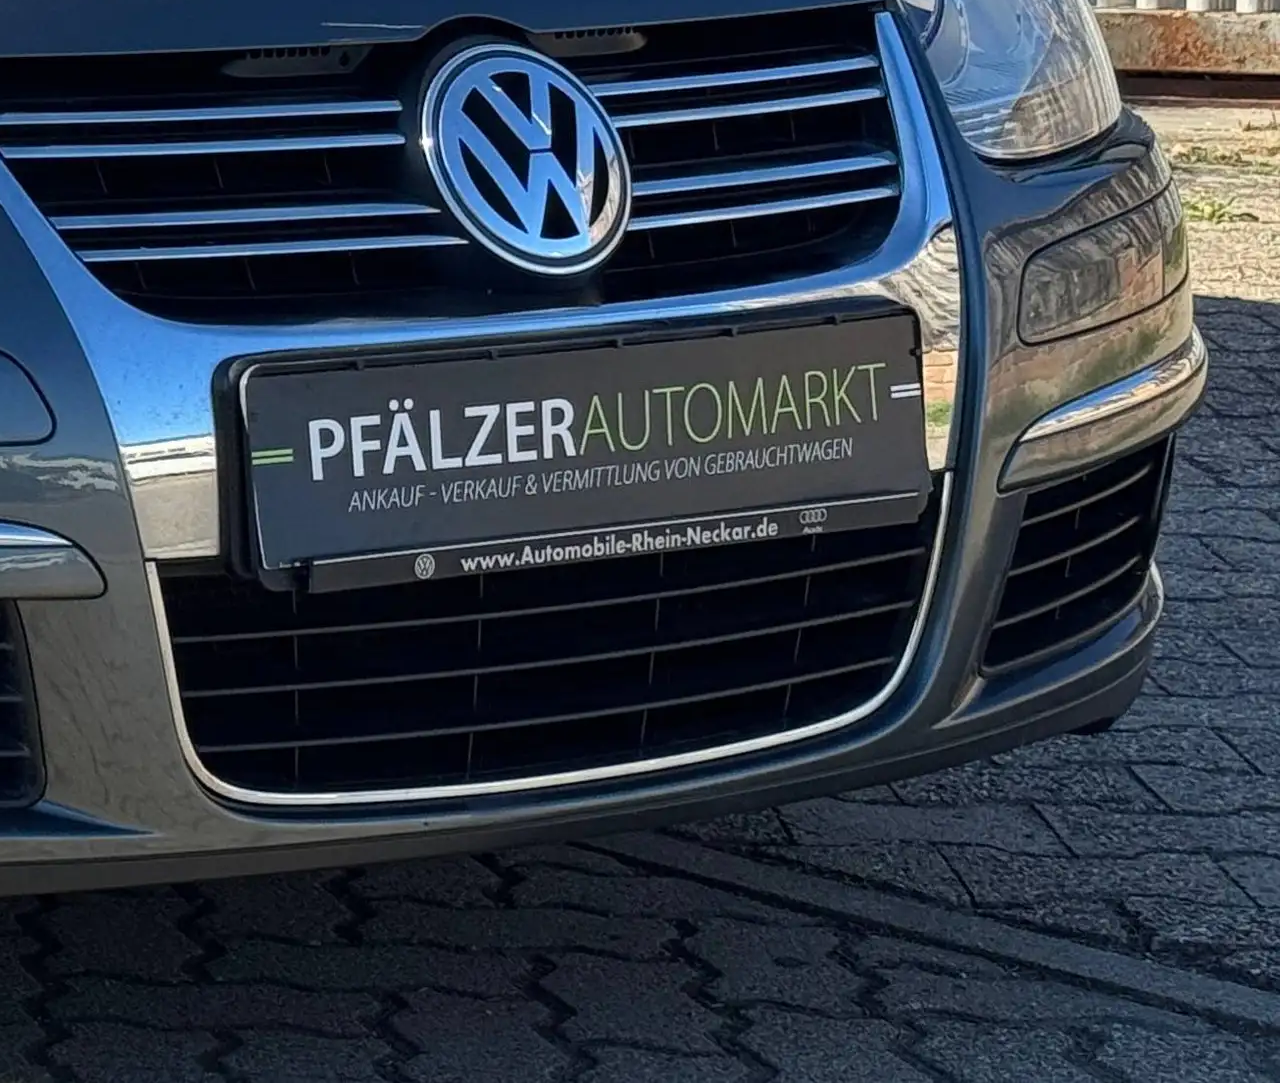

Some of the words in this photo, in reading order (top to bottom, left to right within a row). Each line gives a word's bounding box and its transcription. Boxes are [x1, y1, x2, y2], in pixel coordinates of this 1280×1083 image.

[347, 484, 425, 513] ANKAUF
[440, 474, 522, 504] VERKAUF
[524, 480, 538, 496] &
[541, 459, 660, 493] VERMITTLUNG
[663, 456, 701, 481] VON
[704, 437, 853, 475] GEBRAUCHTWAGEN
[460, 517, 778, 572] www.Automobile-Rhein-Neckar.de
